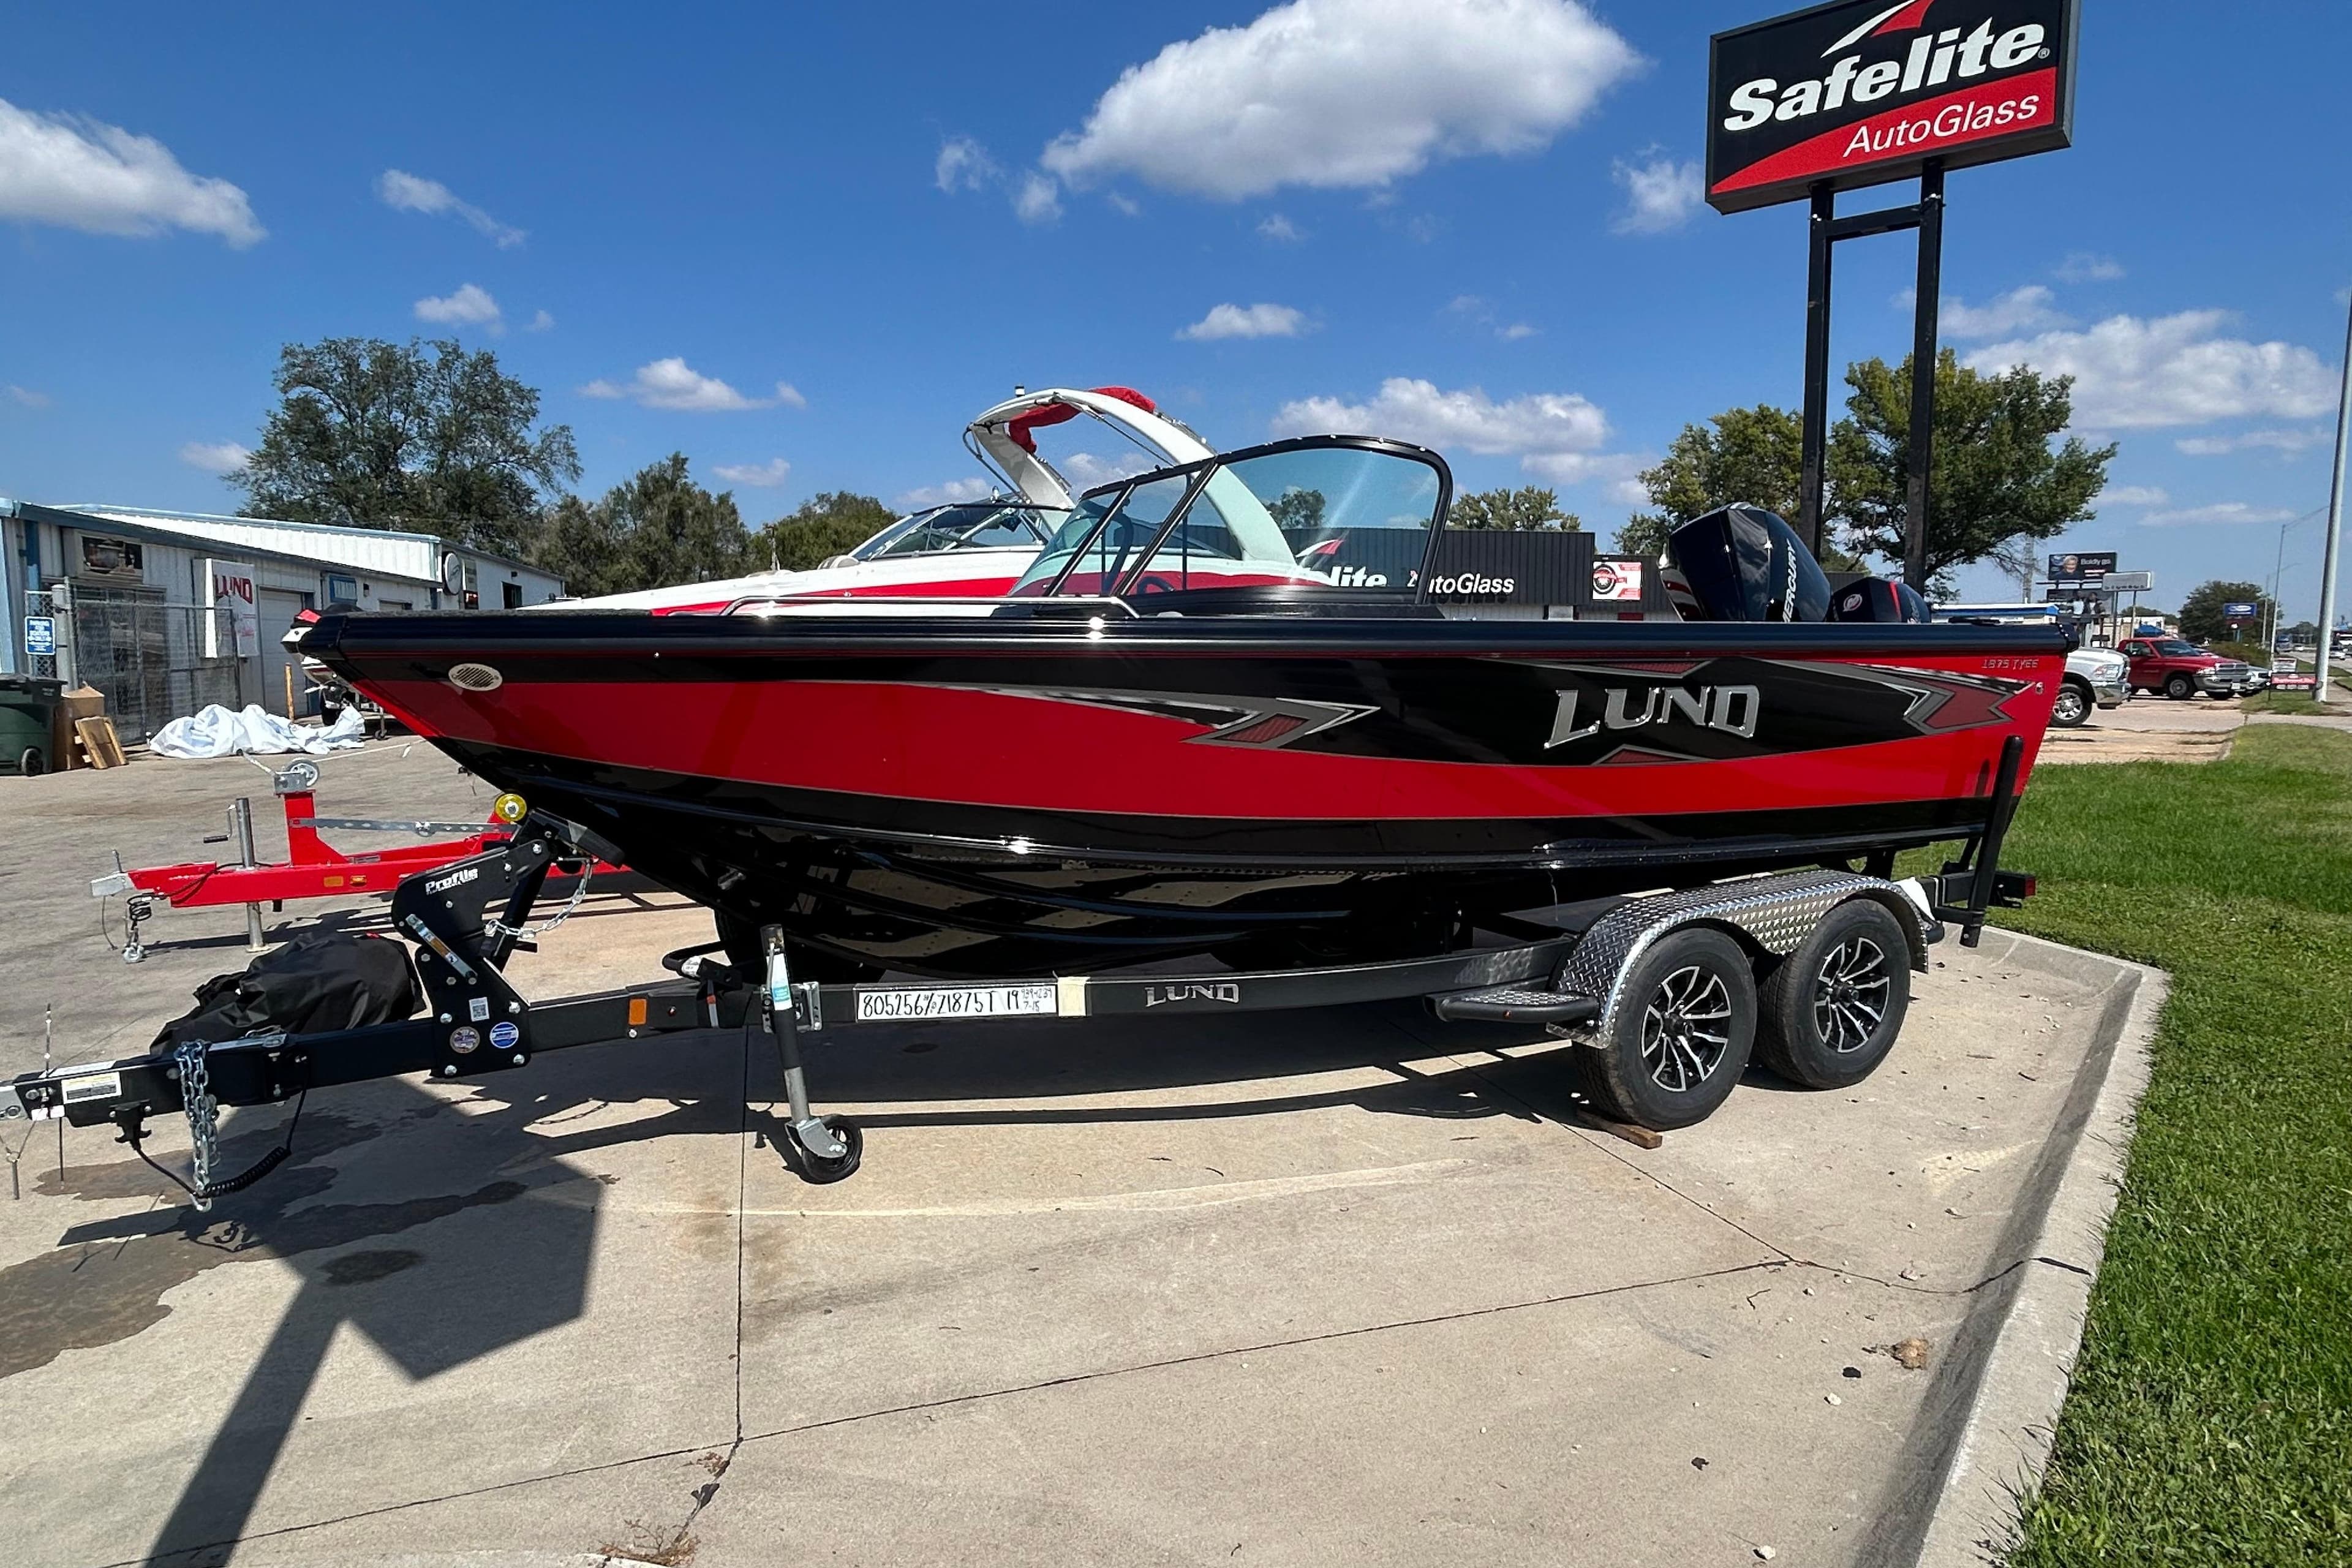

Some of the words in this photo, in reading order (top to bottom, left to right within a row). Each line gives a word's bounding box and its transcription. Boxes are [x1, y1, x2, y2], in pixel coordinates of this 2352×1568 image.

[1724, 17, 2045, 132] Safelite
[1842, 94, 2040, 158] AutoGlass
[1544, 685, 1760, 749] LUND
[1144, 983, 1239, 1008] LUND
